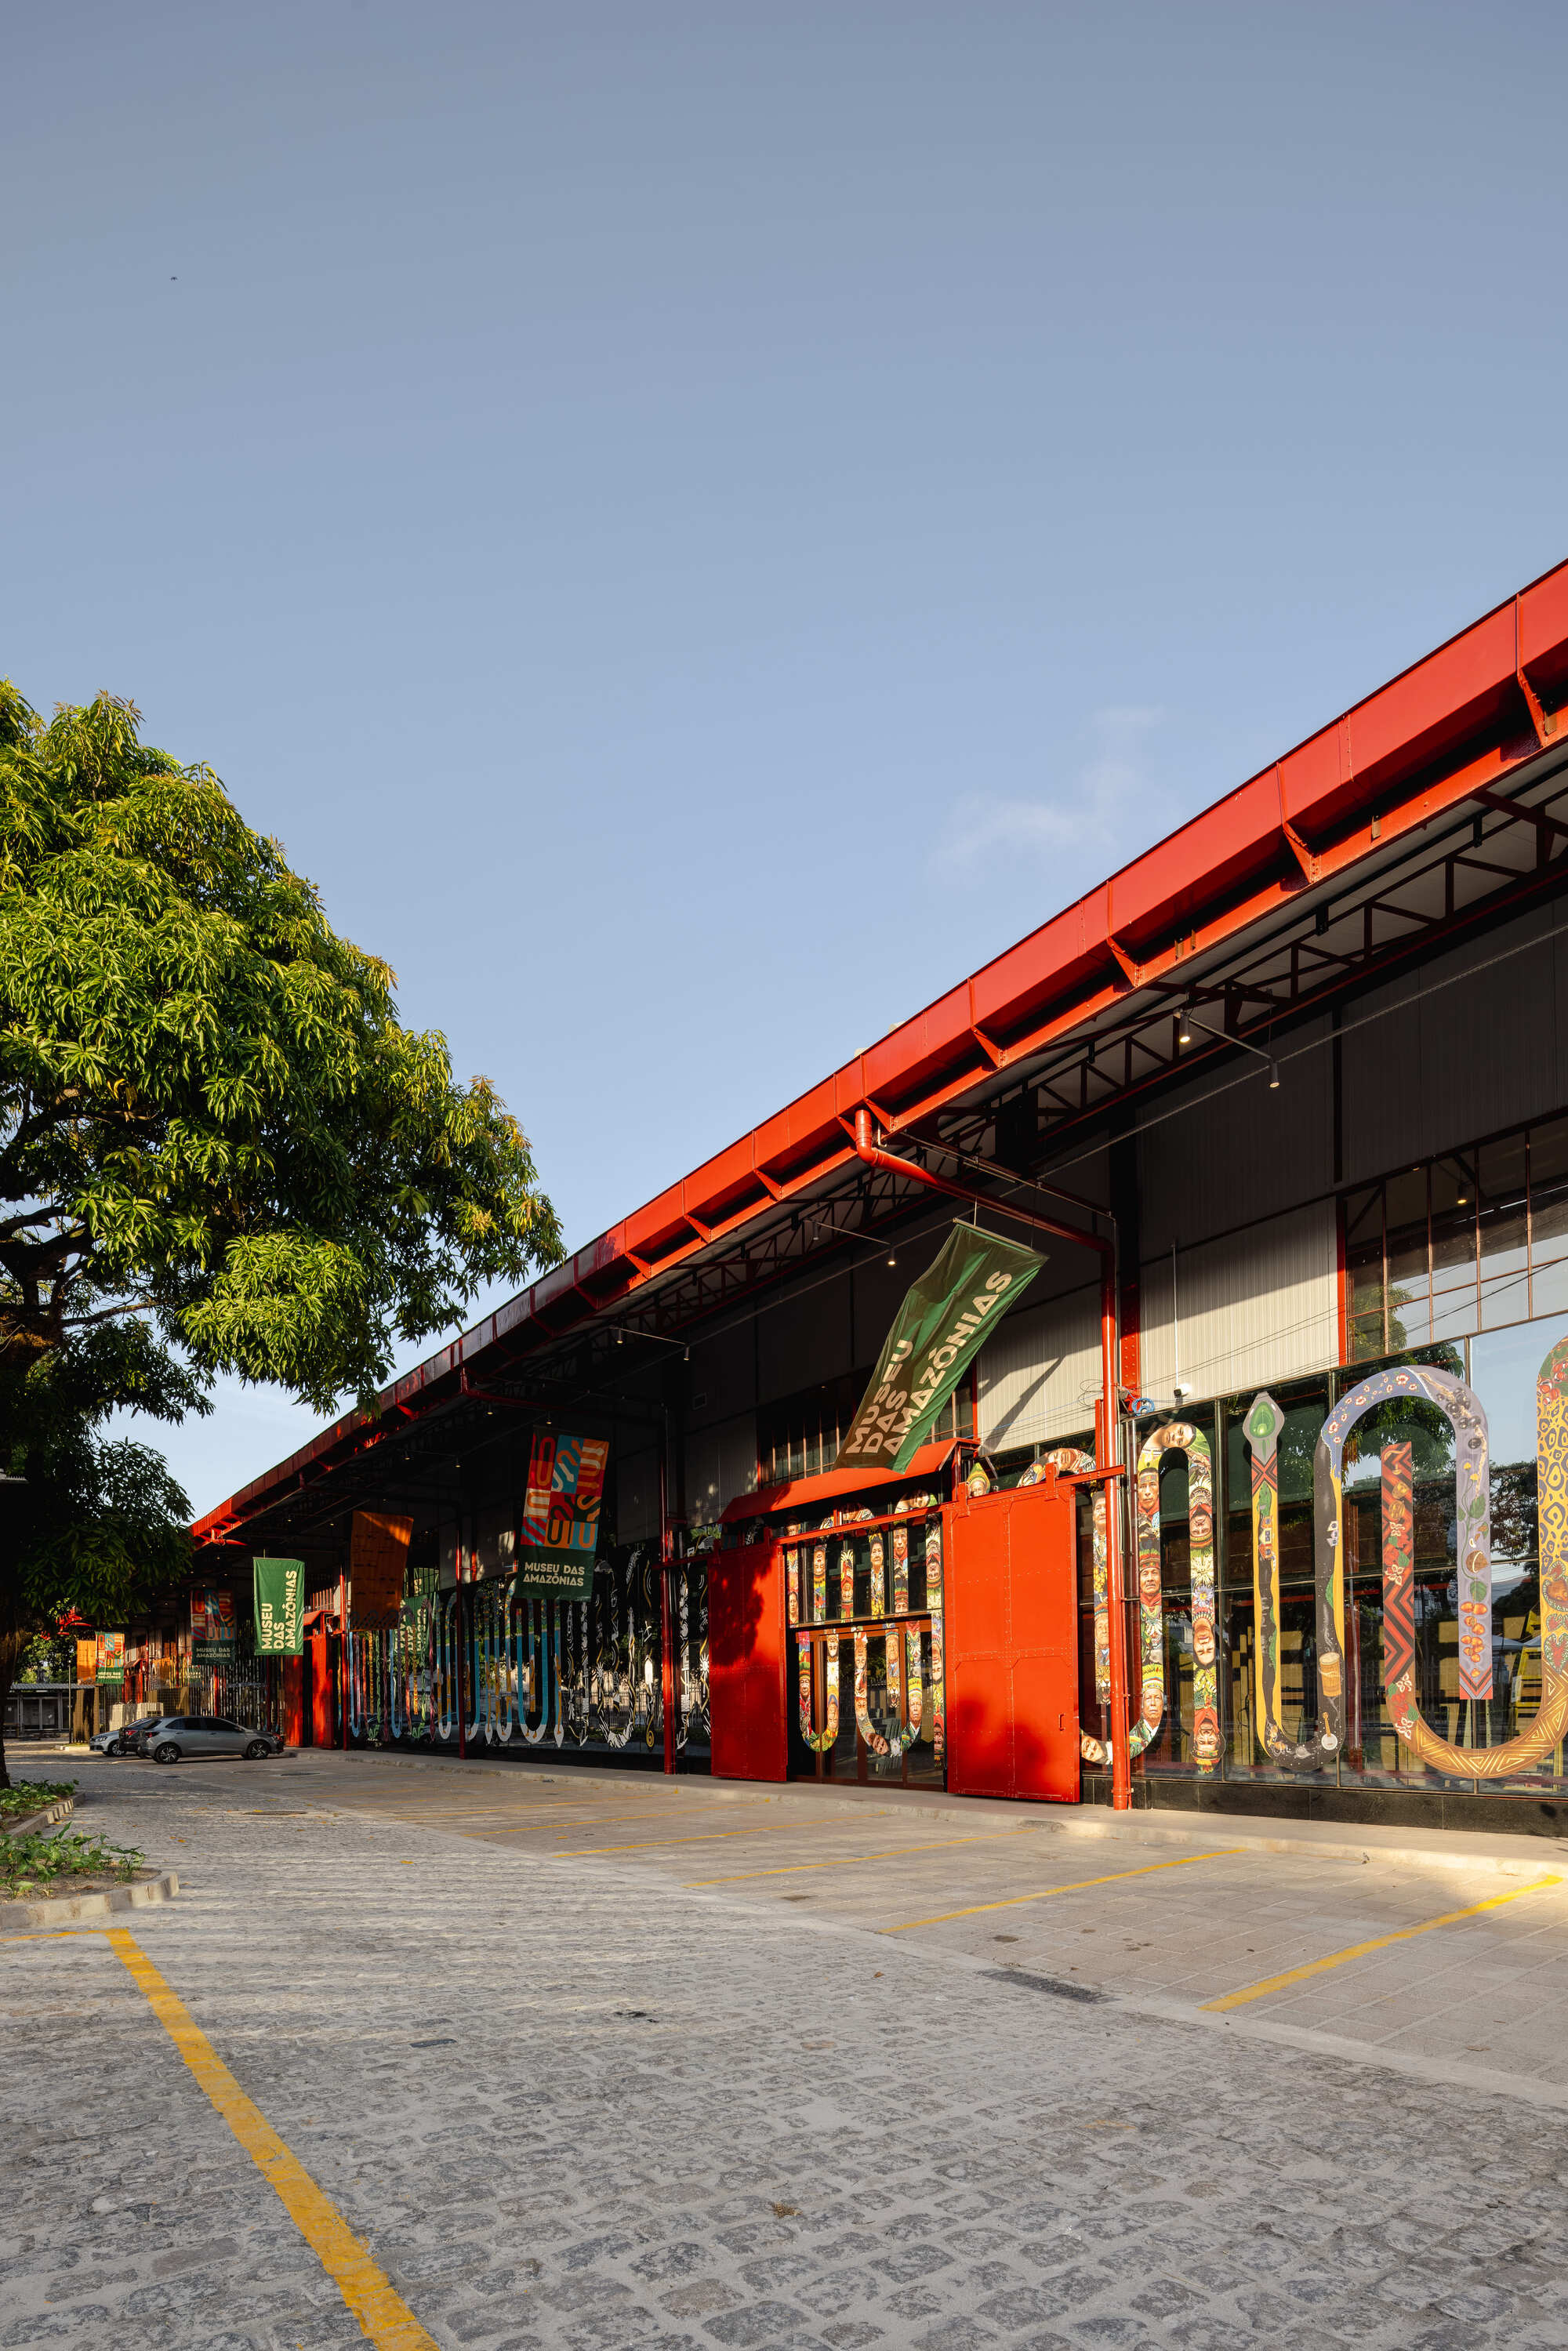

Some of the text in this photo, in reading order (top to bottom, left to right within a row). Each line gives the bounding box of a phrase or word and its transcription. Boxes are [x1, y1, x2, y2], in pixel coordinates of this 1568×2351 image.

[883, 1270, 1013, 1456] AMAZÔNIAS
[845, 1339, 913, 1453] MUSEU
[862, 1389, 908, 1453] DAS
[523, 1573, 584, 1587] AMAZÔNIAS
[524, 1562, 585, 1576] MUSEU DAS
[261, 1603, 273, 1649] MUSEU
[273, 1622, 285, 1649] DAS
[282, 1570, 297, 1649] AMAZÔNIAS
